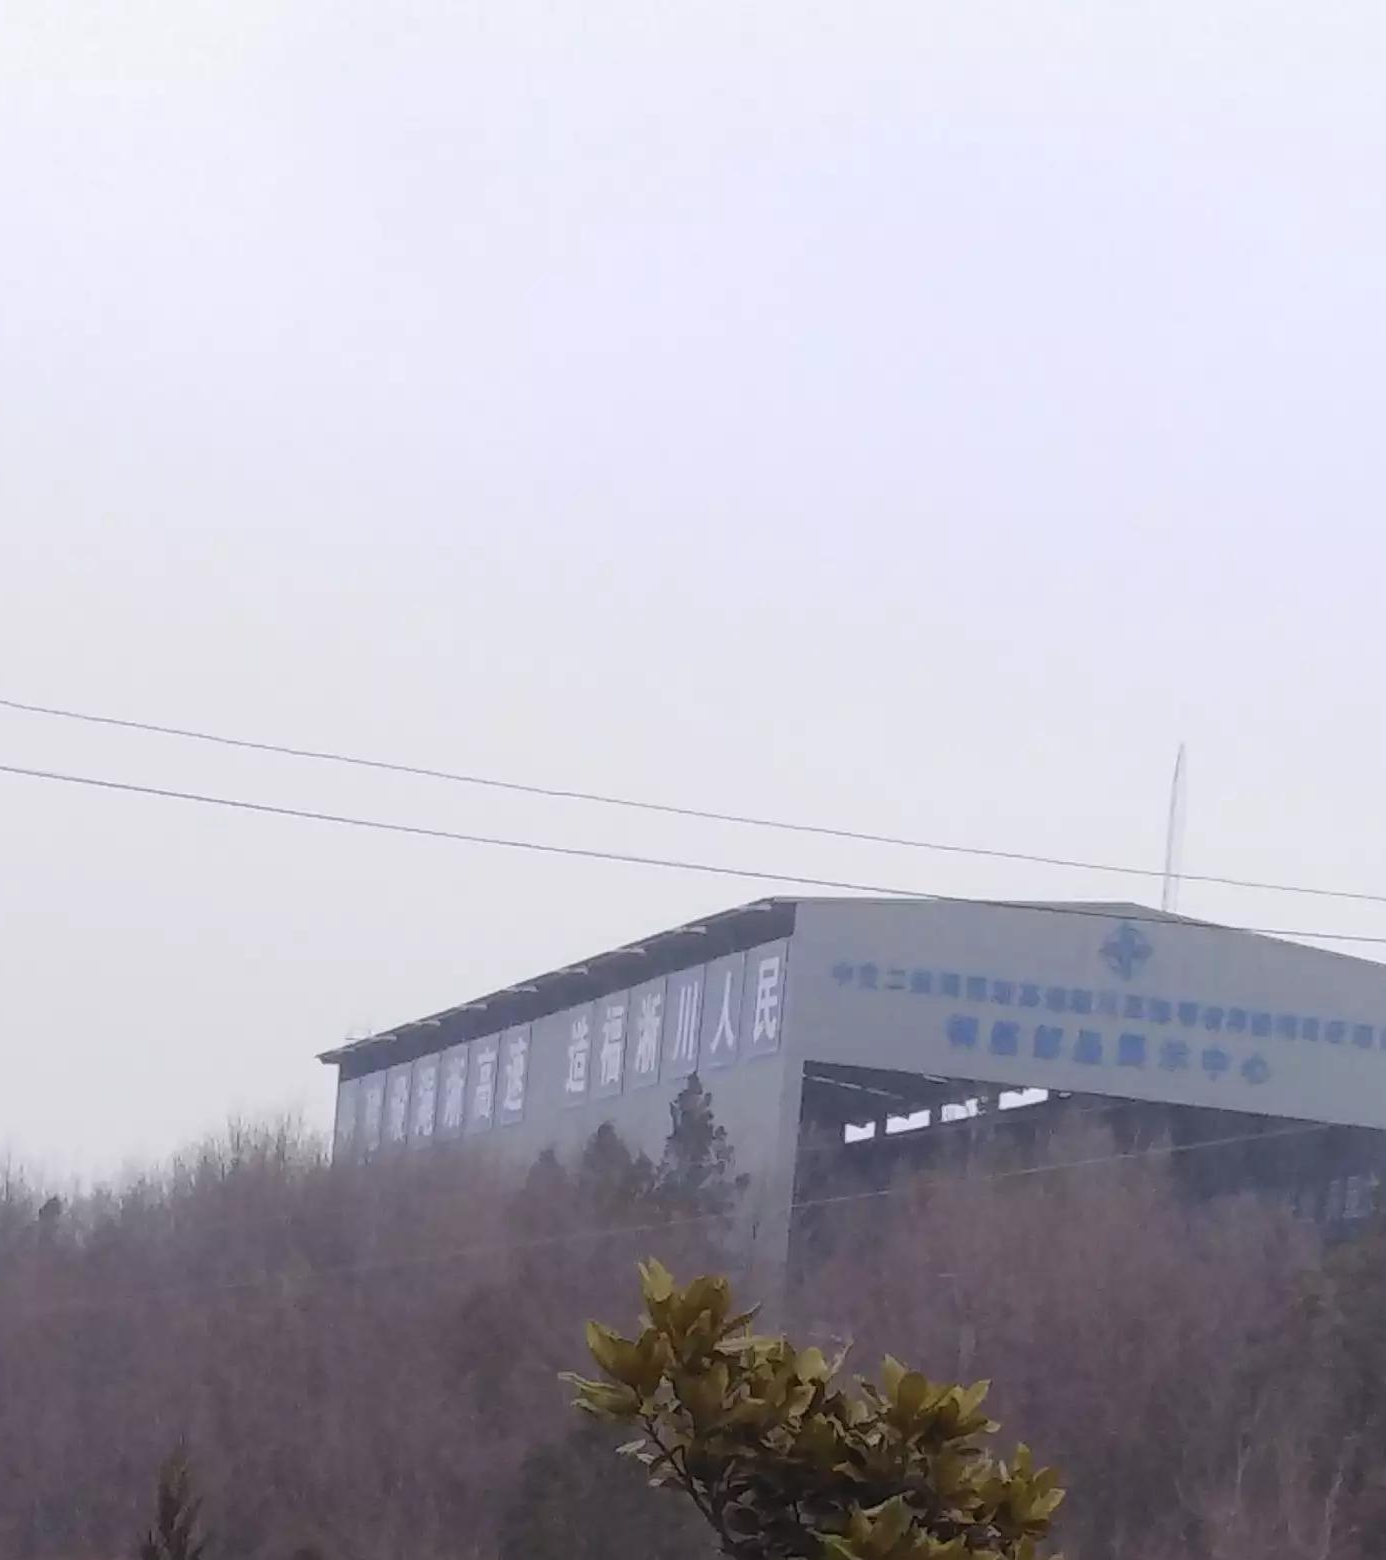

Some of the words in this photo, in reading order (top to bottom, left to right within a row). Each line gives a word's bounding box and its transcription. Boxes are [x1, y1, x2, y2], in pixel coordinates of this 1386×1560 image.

[566, 956, 781, 1093] 造福淅川人民
